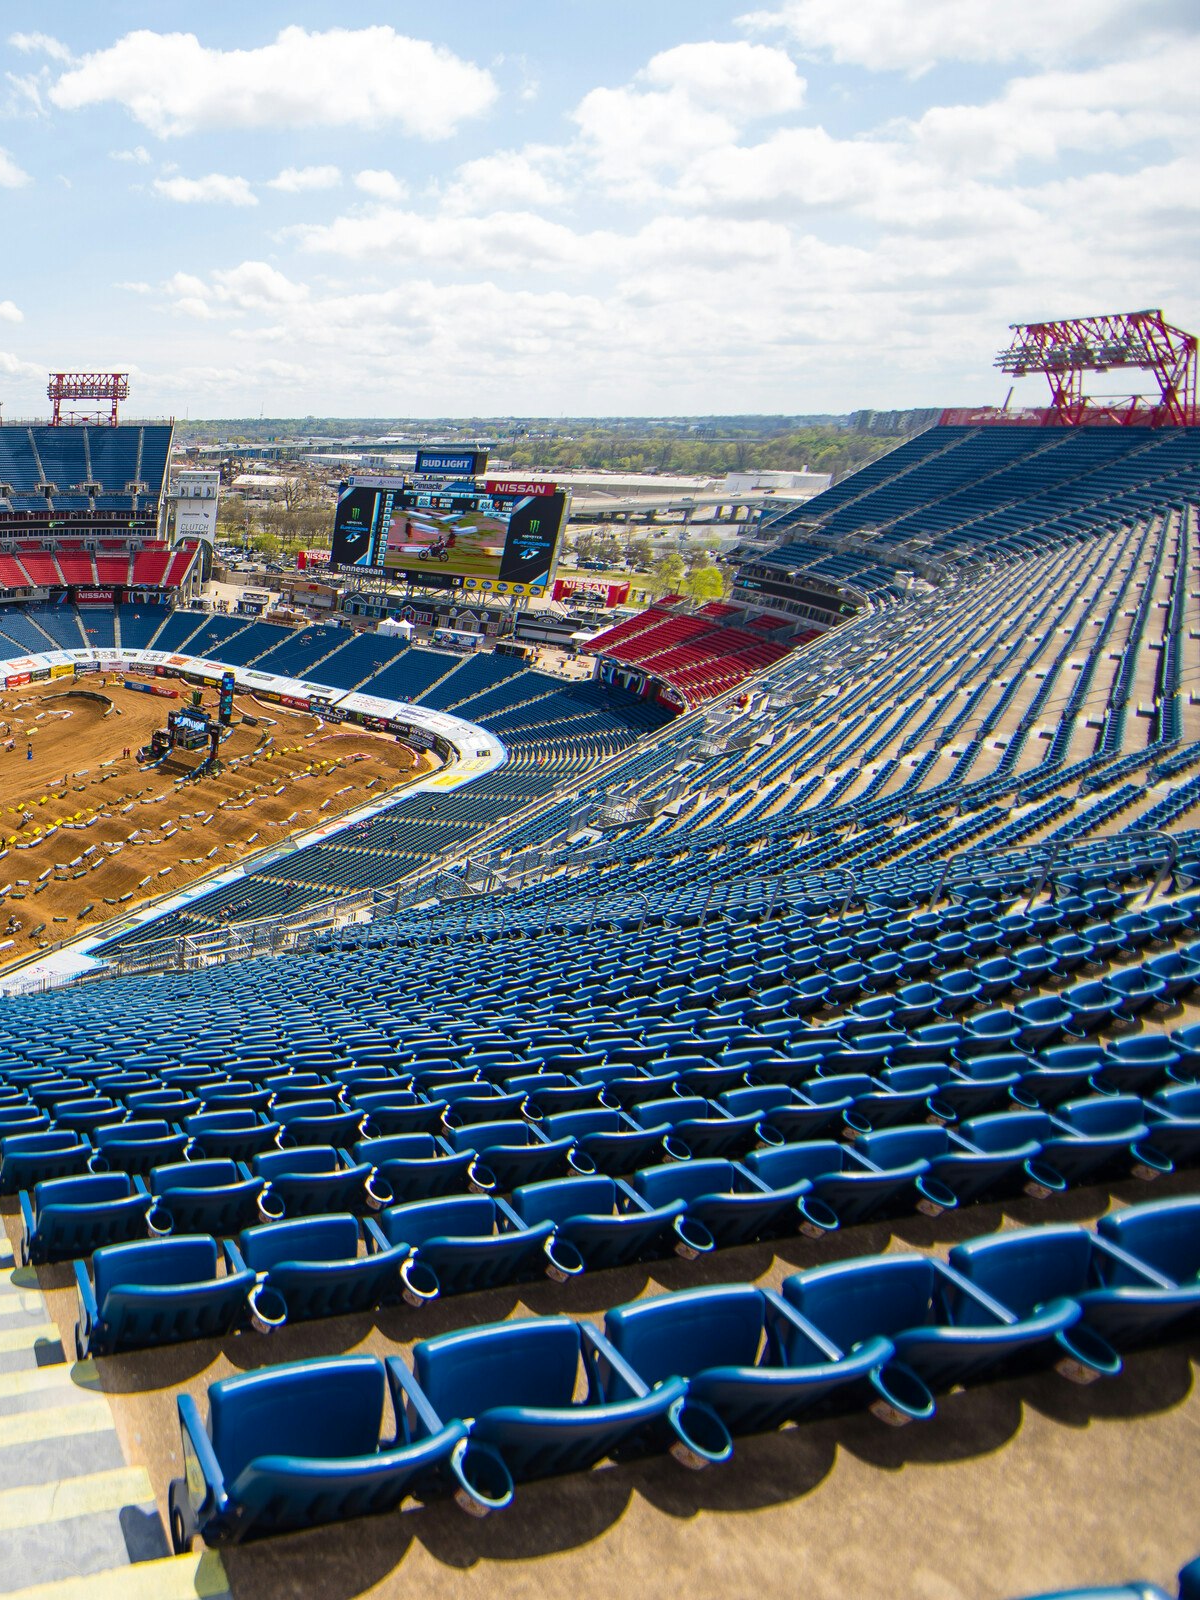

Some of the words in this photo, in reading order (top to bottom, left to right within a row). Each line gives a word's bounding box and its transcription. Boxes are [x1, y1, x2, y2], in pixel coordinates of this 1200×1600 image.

[422, 459, 440, 468] BUD
[441, 460, 470, 469] LIGHT
[414, 481, 443, 491] Pinnacle
[494, 483, 546, 494] NISSAN
[180, 523, 209, 531] CLUTCH
[304, 552, 332, 561] NISSA
[562, 580, 609, 592] NISSAN
[388, 722, 409, 732] TOYOTA
